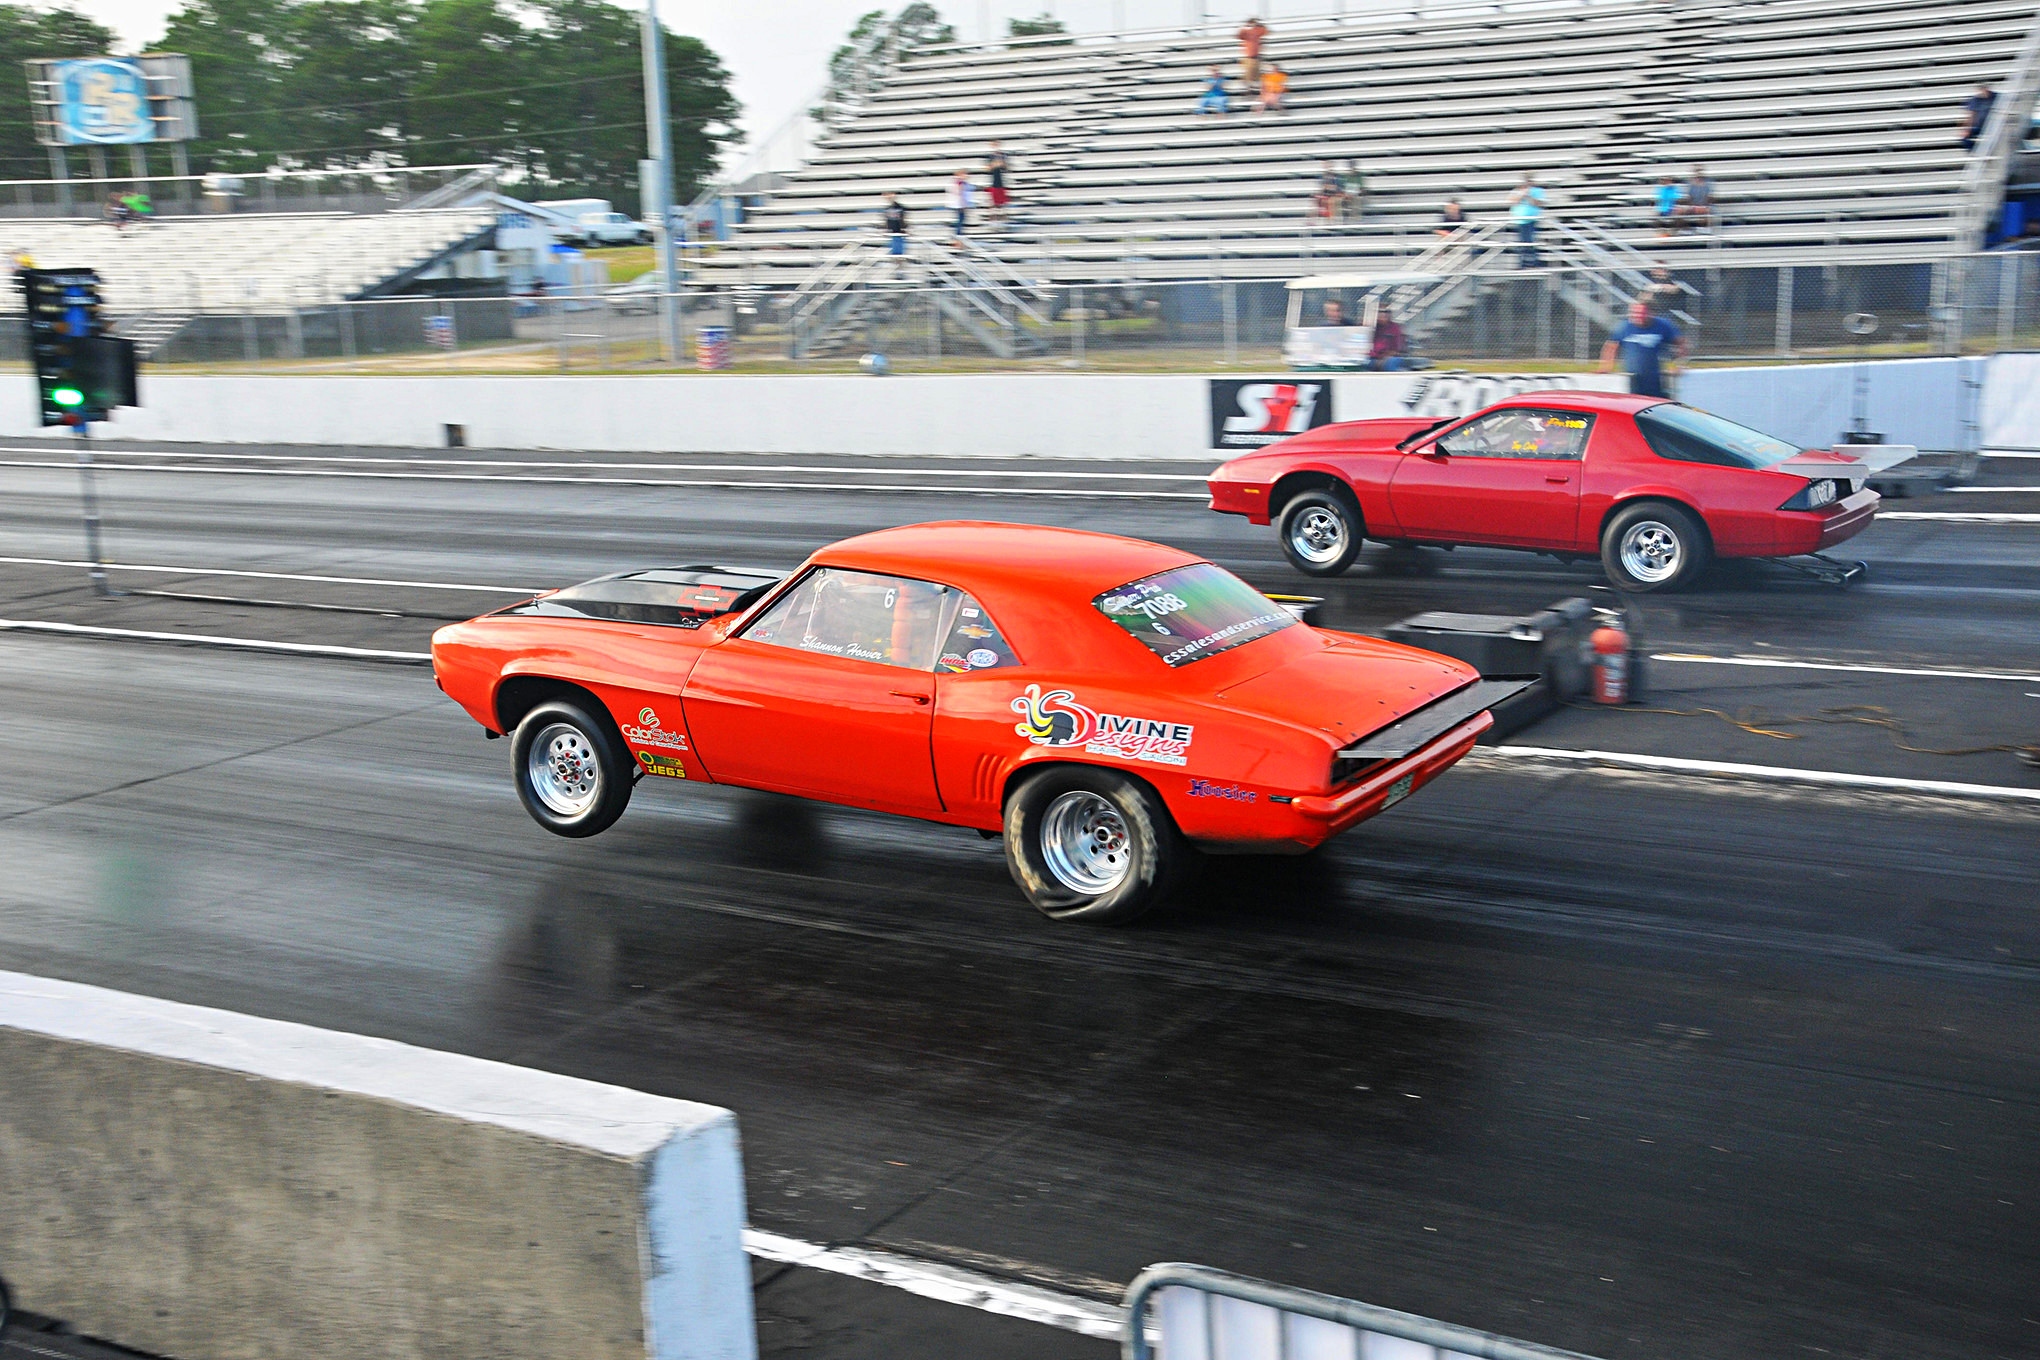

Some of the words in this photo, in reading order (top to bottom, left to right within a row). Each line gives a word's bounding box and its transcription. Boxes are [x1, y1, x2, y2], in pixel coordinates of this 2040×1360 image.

[884, 588, 895, 609] 6
[1132, 592, 1188, 620] 7088
[1151, 622, 1172, 636] 6
[799, 635, 844, 654] Shannon
[846, 642, 883, 660] Hoover
